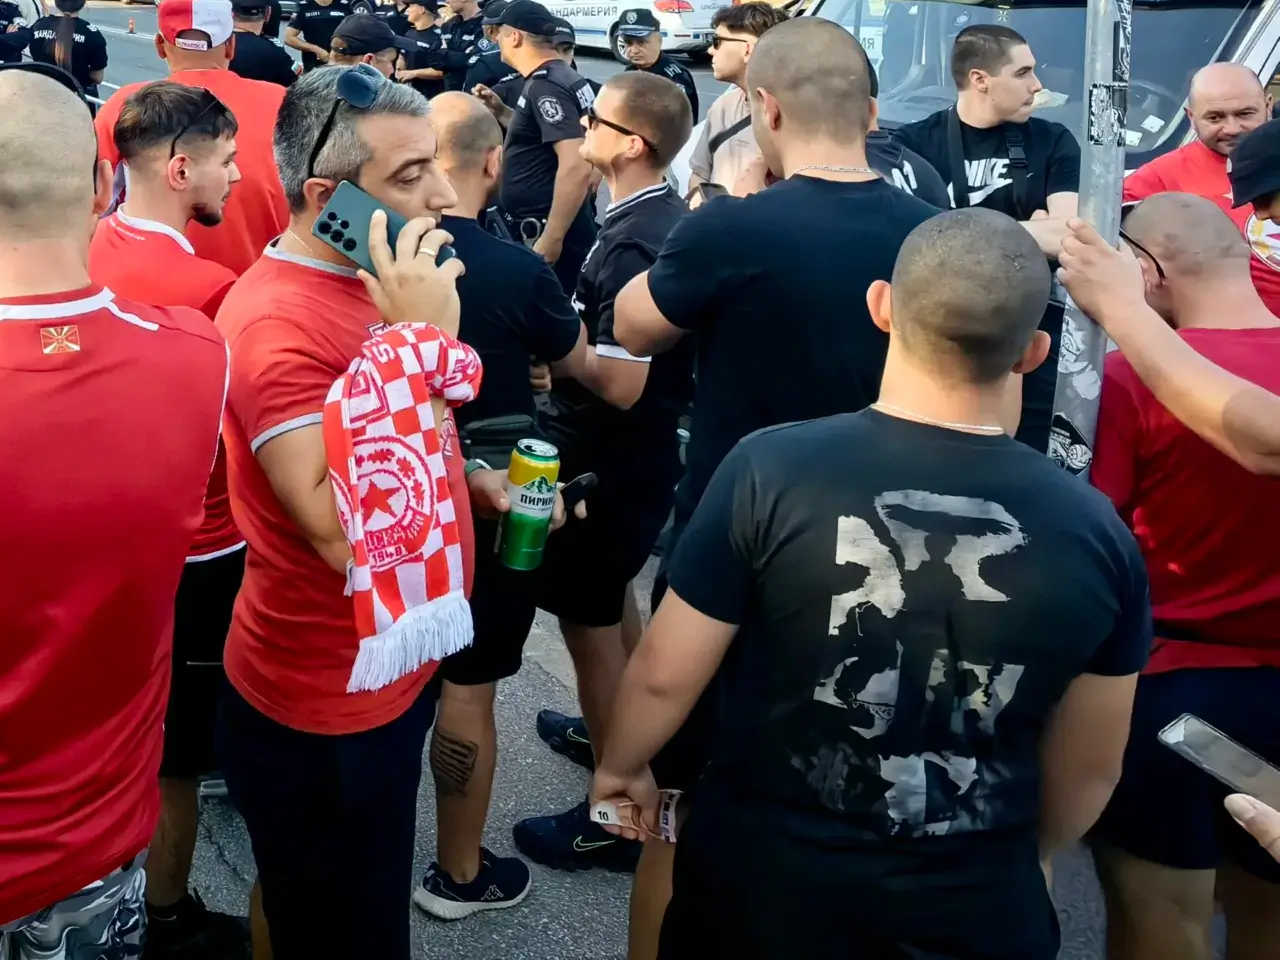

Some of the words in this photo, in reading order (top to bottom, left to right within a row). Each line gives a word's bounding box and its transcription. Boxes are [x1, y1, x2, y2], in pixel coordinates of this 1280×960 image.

[550, 6, 618, 17] АНДАРМЕРИЯ
[963, 158, 1011, 188] NIKE
[520, 494, 554, 507] ПИРИН
[597, 810, 609, 822] 10
